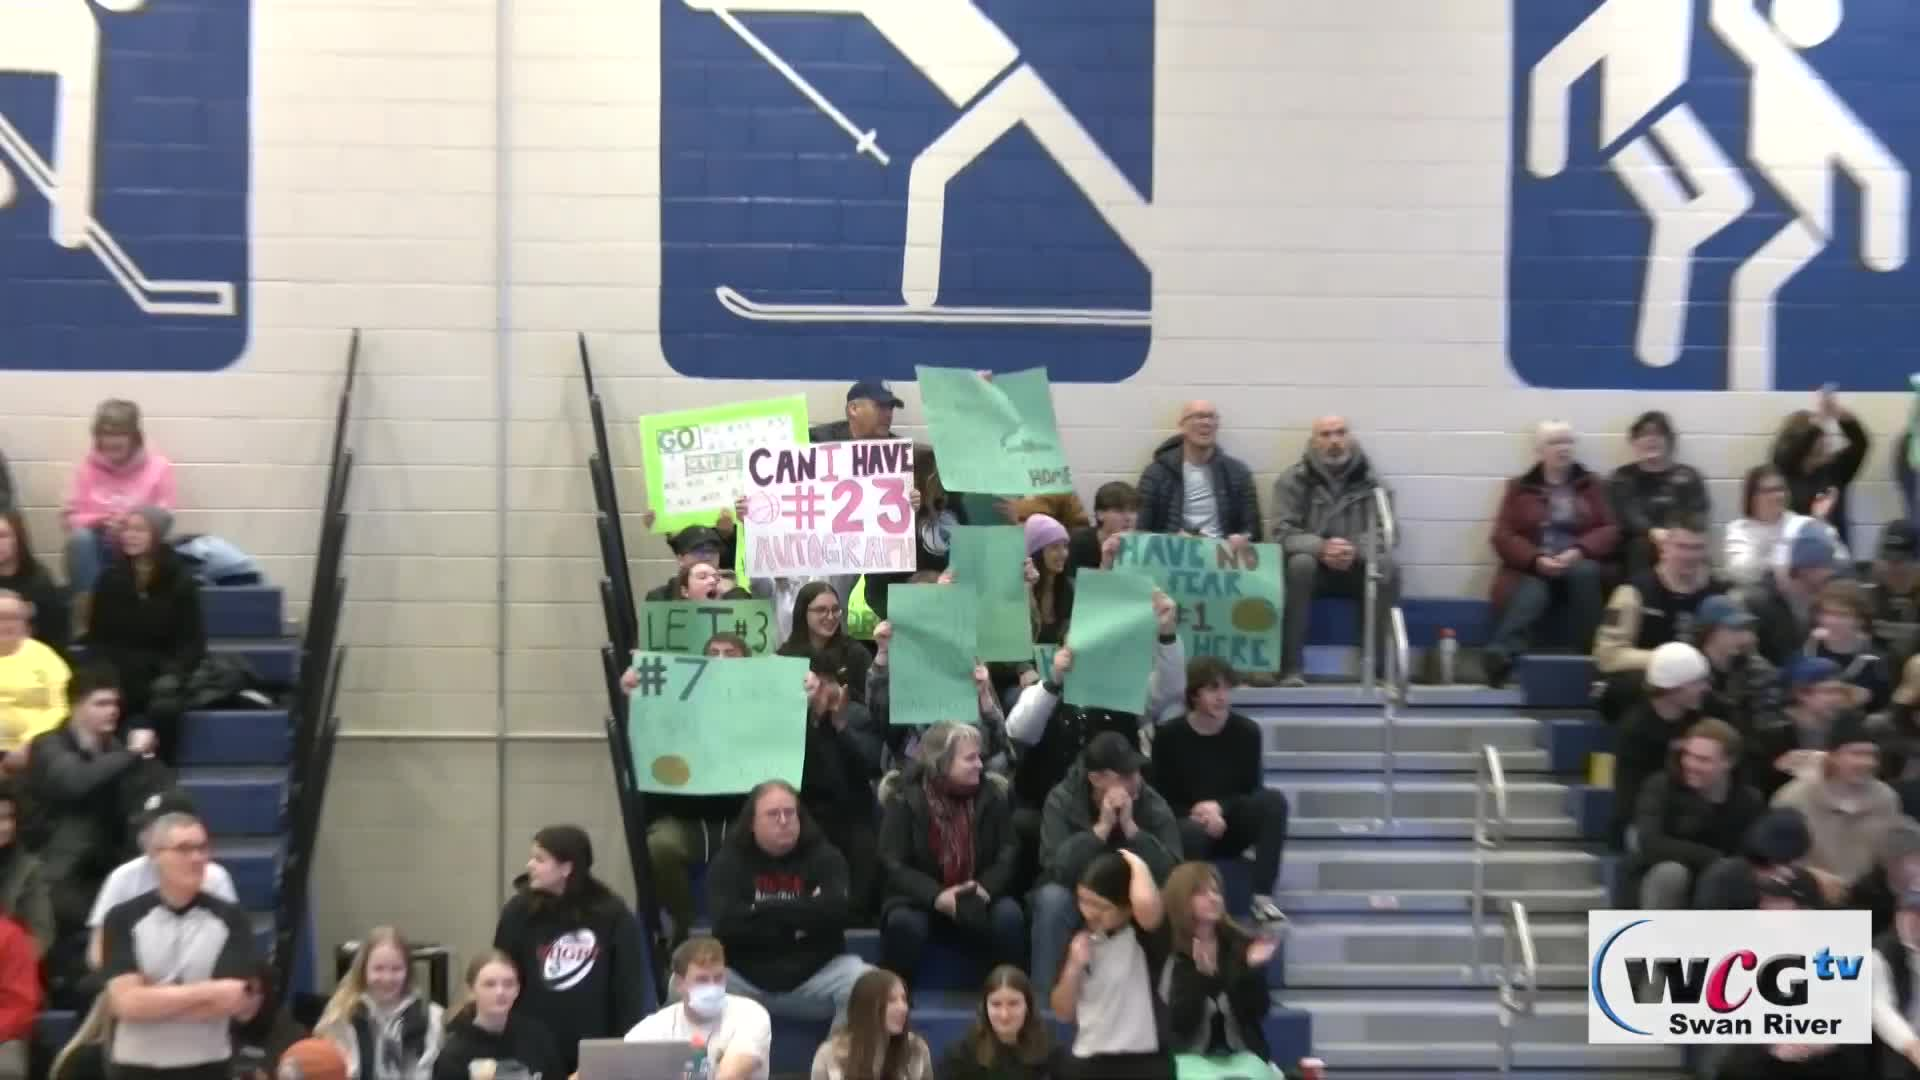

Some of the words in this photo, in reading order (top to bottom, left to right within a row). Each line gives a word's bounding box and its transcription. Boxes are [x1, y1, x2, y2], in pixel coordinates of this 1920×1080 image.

[657, 428, 694, 450] GO
[750, 447, 816, 486] CAN
[819, 443, 842, 481] I
[852, 443, 913, 476] HAVE
[1027, 466, 1072, 487] HOME
[782, 477, 911, 534] #23
[755, 534, 914, 571] AUTOGRAPH
[1119, 536, 1205, 567] HAVE
[1217, 543, 1260, 571] NO
[1168, 571, 1241, 596] FEAR
[648, 607, 733, 652] LET
[735, 611, 768, 652] #3
[1193, 636, 1270, 666] HERE
[638, 656, 709, 700] #7
